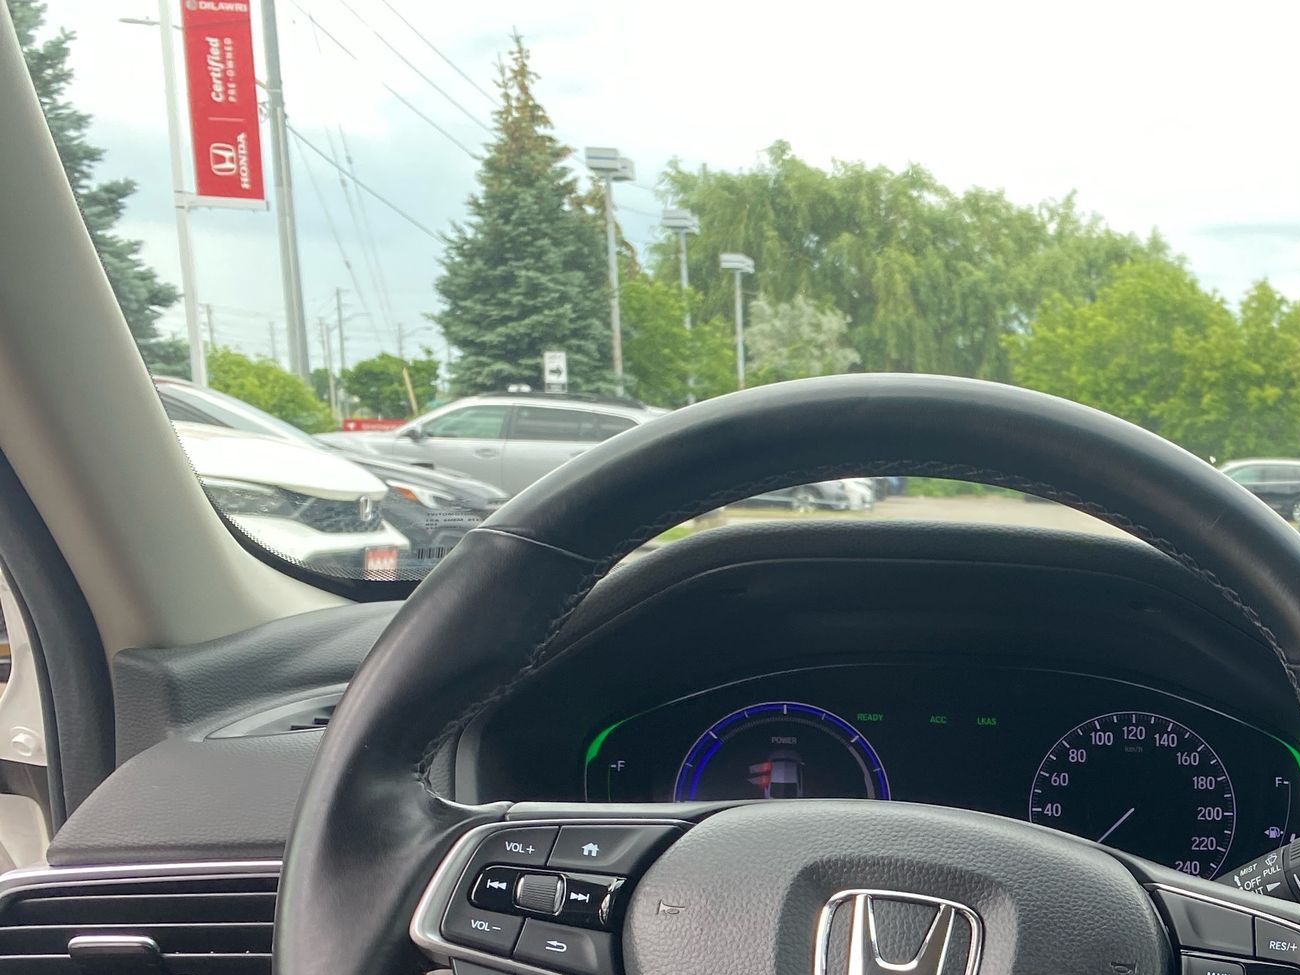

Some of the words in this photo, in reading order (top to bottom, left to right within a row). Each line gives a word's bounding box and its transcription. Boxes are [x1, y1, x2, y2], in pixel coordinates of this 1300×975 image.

[205, 36, 225, 103] Certified
[237, 132, 251, 190] HONDA
[857, 713, 884, 721] READY
[930, 715, 947, 724] ACC
[1090, 731, 1114, 746] 100
[1122, 726, 1146, 740] 120
[771, 736, 797, 745] POWER
[1154, 733, 1178, 748] 140
[1068, 749, 1087, 763] 80
[1176, 752, 1200, 766] 160
[1051, 773, 1069, 787] 60
[1192, 776, 1216, 790] 180
[1275, 777, 1283, 788] F
[1043, 803, 1062, 817] 40
[1197, 807, 1223, 821] 200
[1191, 837, 1217, 851] 220
[1175, 861, 1201, 875] 240
[1239, 863, 1258, 876] MIST
[1262, 864, 1282, 877] PULL
[1244, 875, 1262, 891] OFF
[1269, 940, 1298, 952] RES/+
